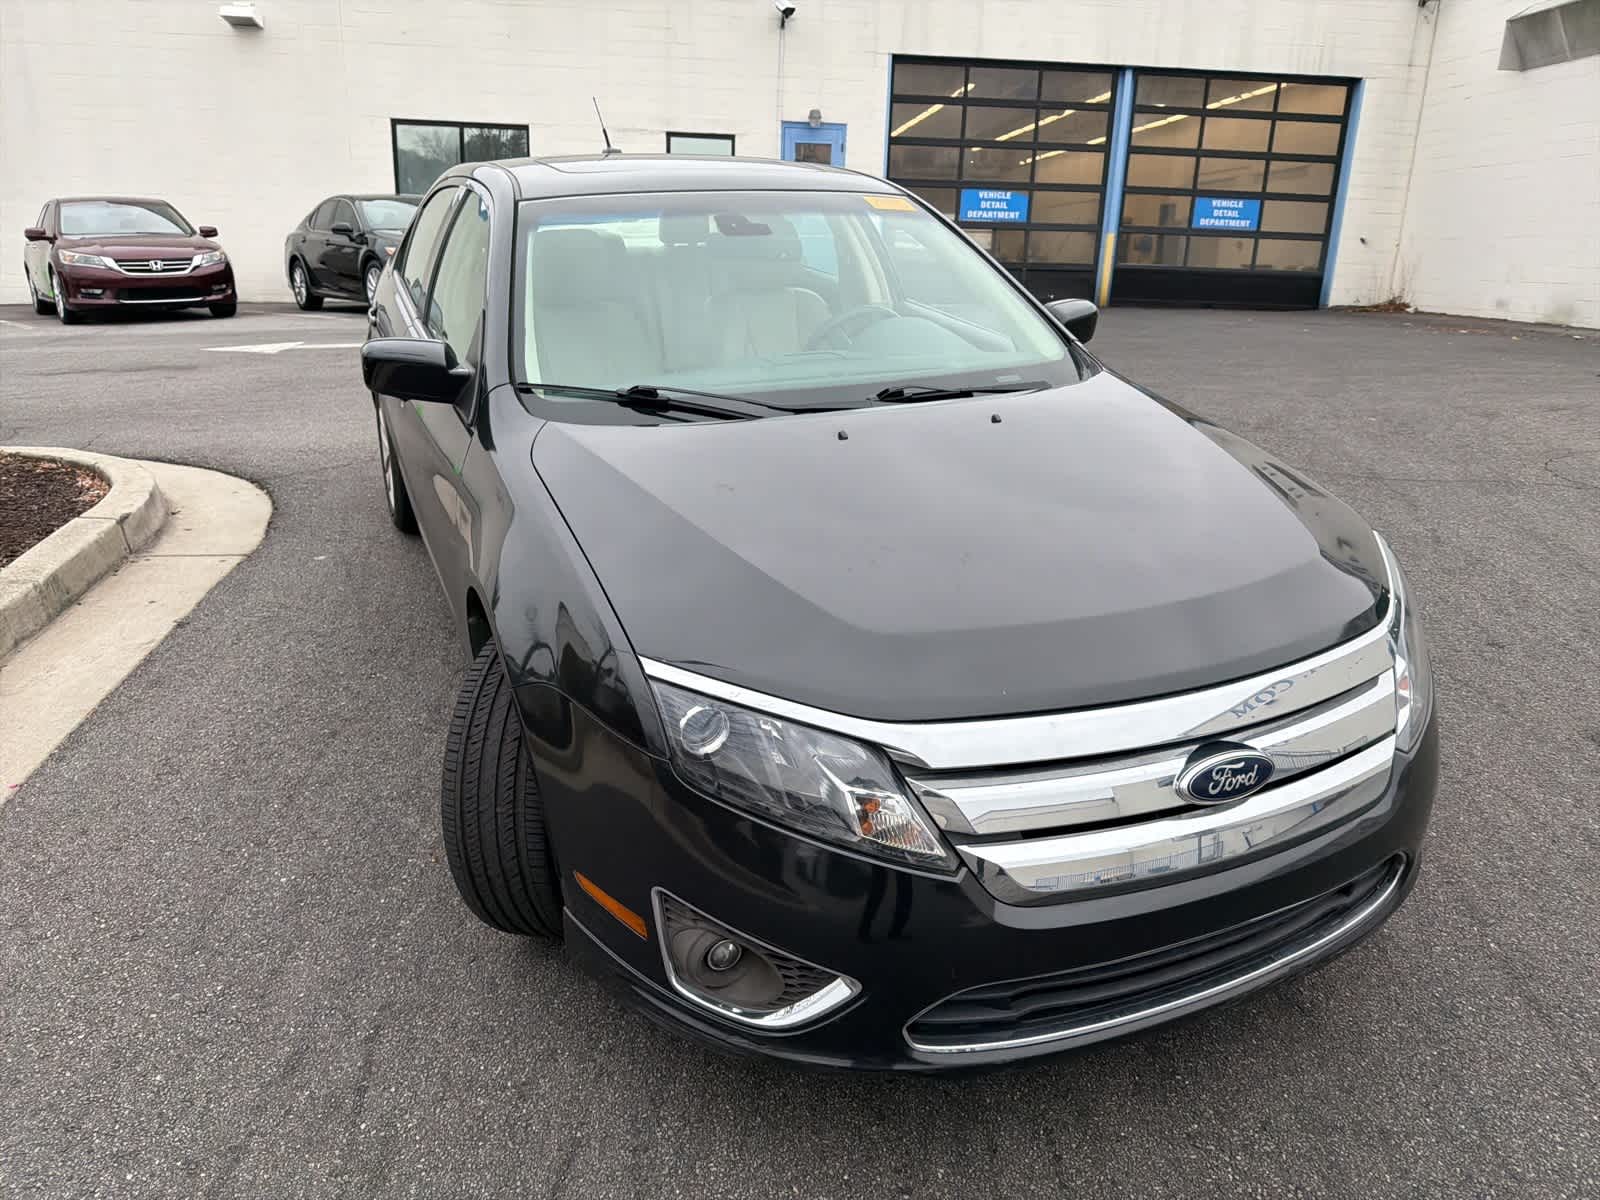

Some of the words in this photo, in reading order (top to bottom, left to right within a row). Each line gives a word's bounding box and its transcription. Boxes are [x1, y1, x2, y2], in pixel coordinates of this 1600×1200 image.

[979, 191, 1012, 199] VEHICLE
[980, 200, 1008, 209] DETAIL
[1212, 200, 1244, 208] VEHICLE
[967, 210, 1020, 219] DEPARTMENT
[1213, 209, 1240, 218] DETAIL
[1200, 218, 1251, 227] DEPARTMENT
[1208, 761, 1259, 795] Ford
